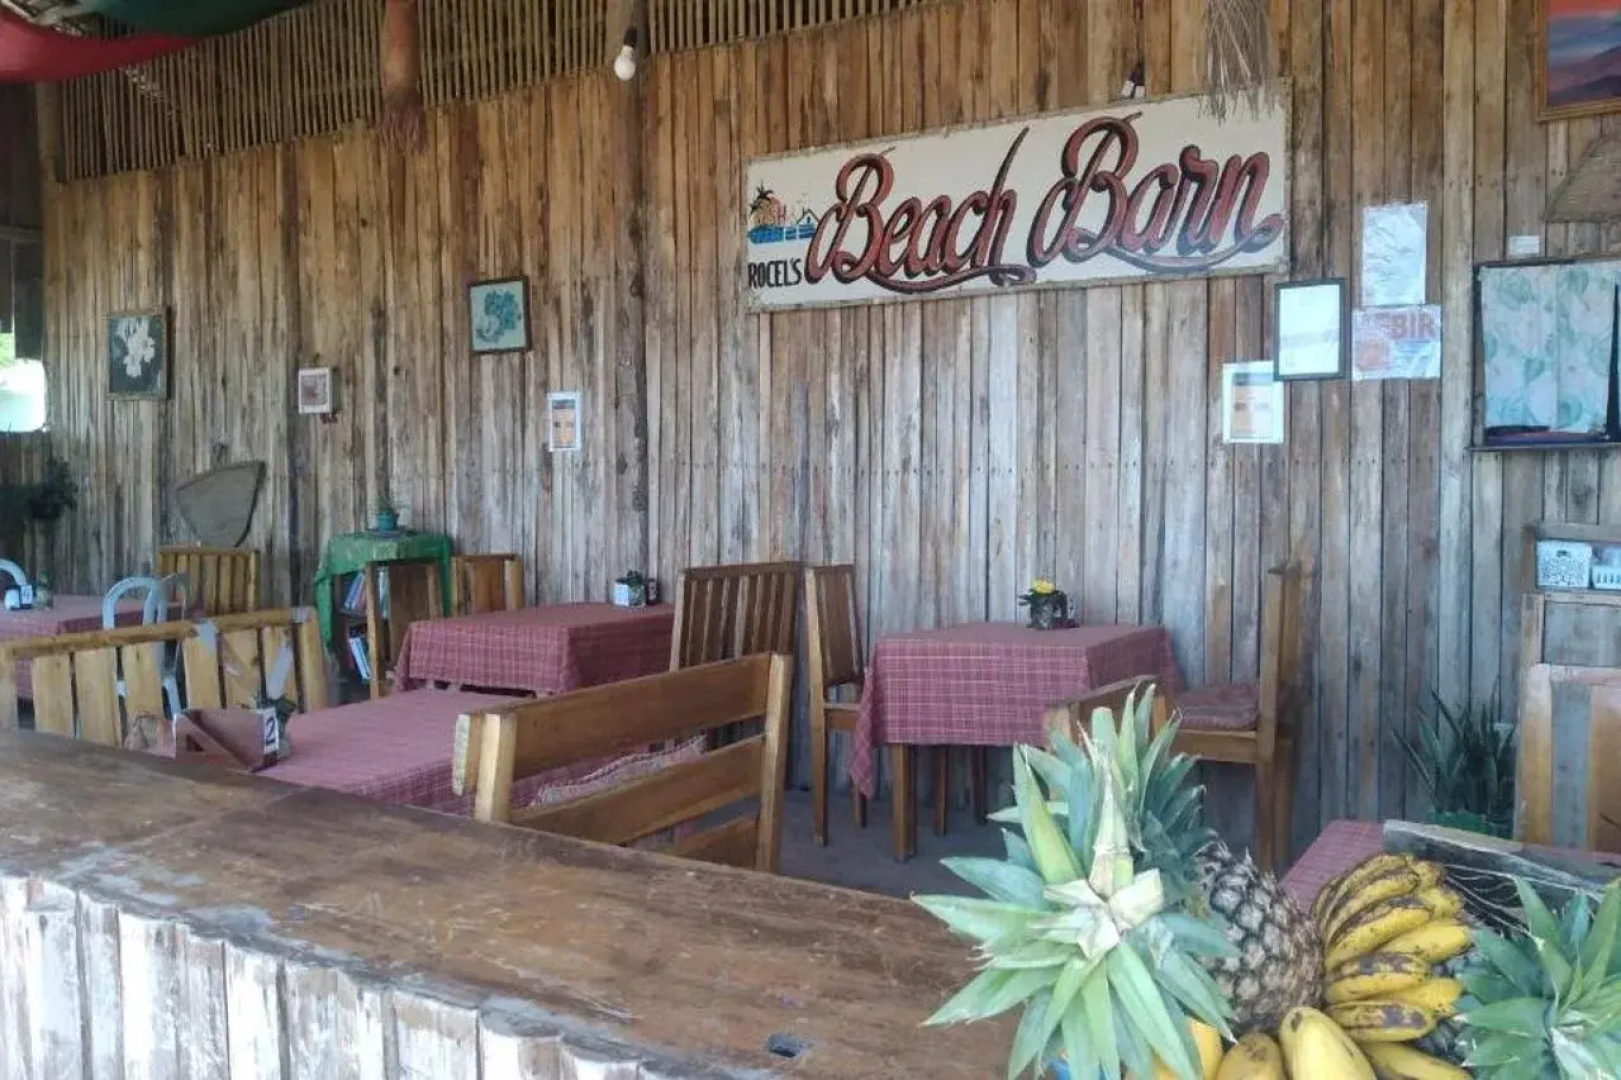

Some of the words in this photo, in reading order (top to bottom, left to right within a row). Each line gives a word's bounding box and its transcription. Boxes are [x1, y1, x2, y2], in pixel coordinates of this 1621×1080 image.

[804, 127, 1036, 294] Beach
[1027, 112, 1285, 274] Barn
[747, 257, 802, 289] ROCEL'S
[265, 716, 276, 746] 2
